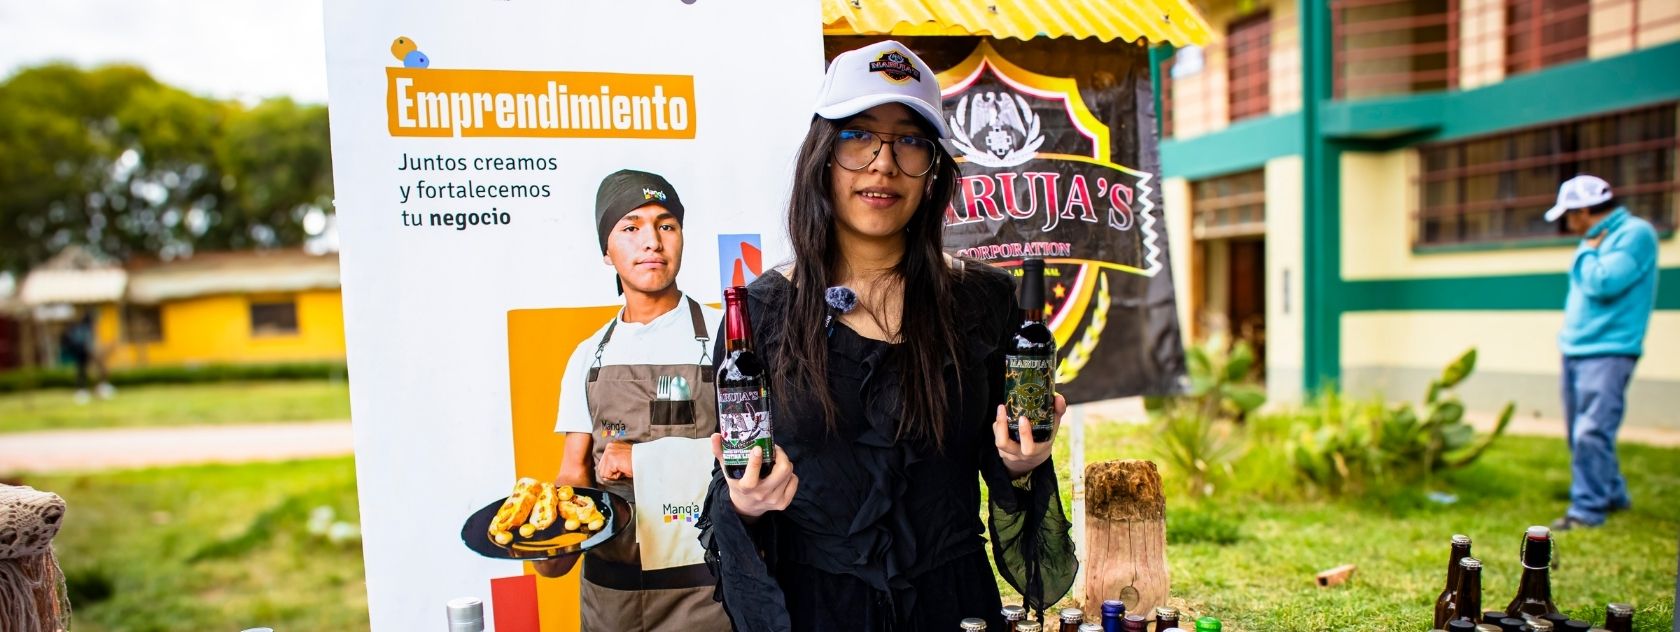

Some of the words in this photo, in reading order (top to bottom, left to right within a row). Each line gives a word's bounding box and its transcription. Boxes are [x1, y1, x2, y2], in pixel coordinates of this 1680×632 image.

[395, 77, 688, 137] Emprendimiento
[398, 153, 467, 171] Juntos
[473, 156, 558, 171] creamos
[399, 185, 411, 204] y
[416, 179, 551, 199] fortalecemos
[945, 172, 1134, 232] RUJA'S
[401, 210, 423, 227] tu
[429, 207, 511, 231] negocio
[601, 420, 626, 432] Manq'a
[662, 502, 700, 516] Manq'a
